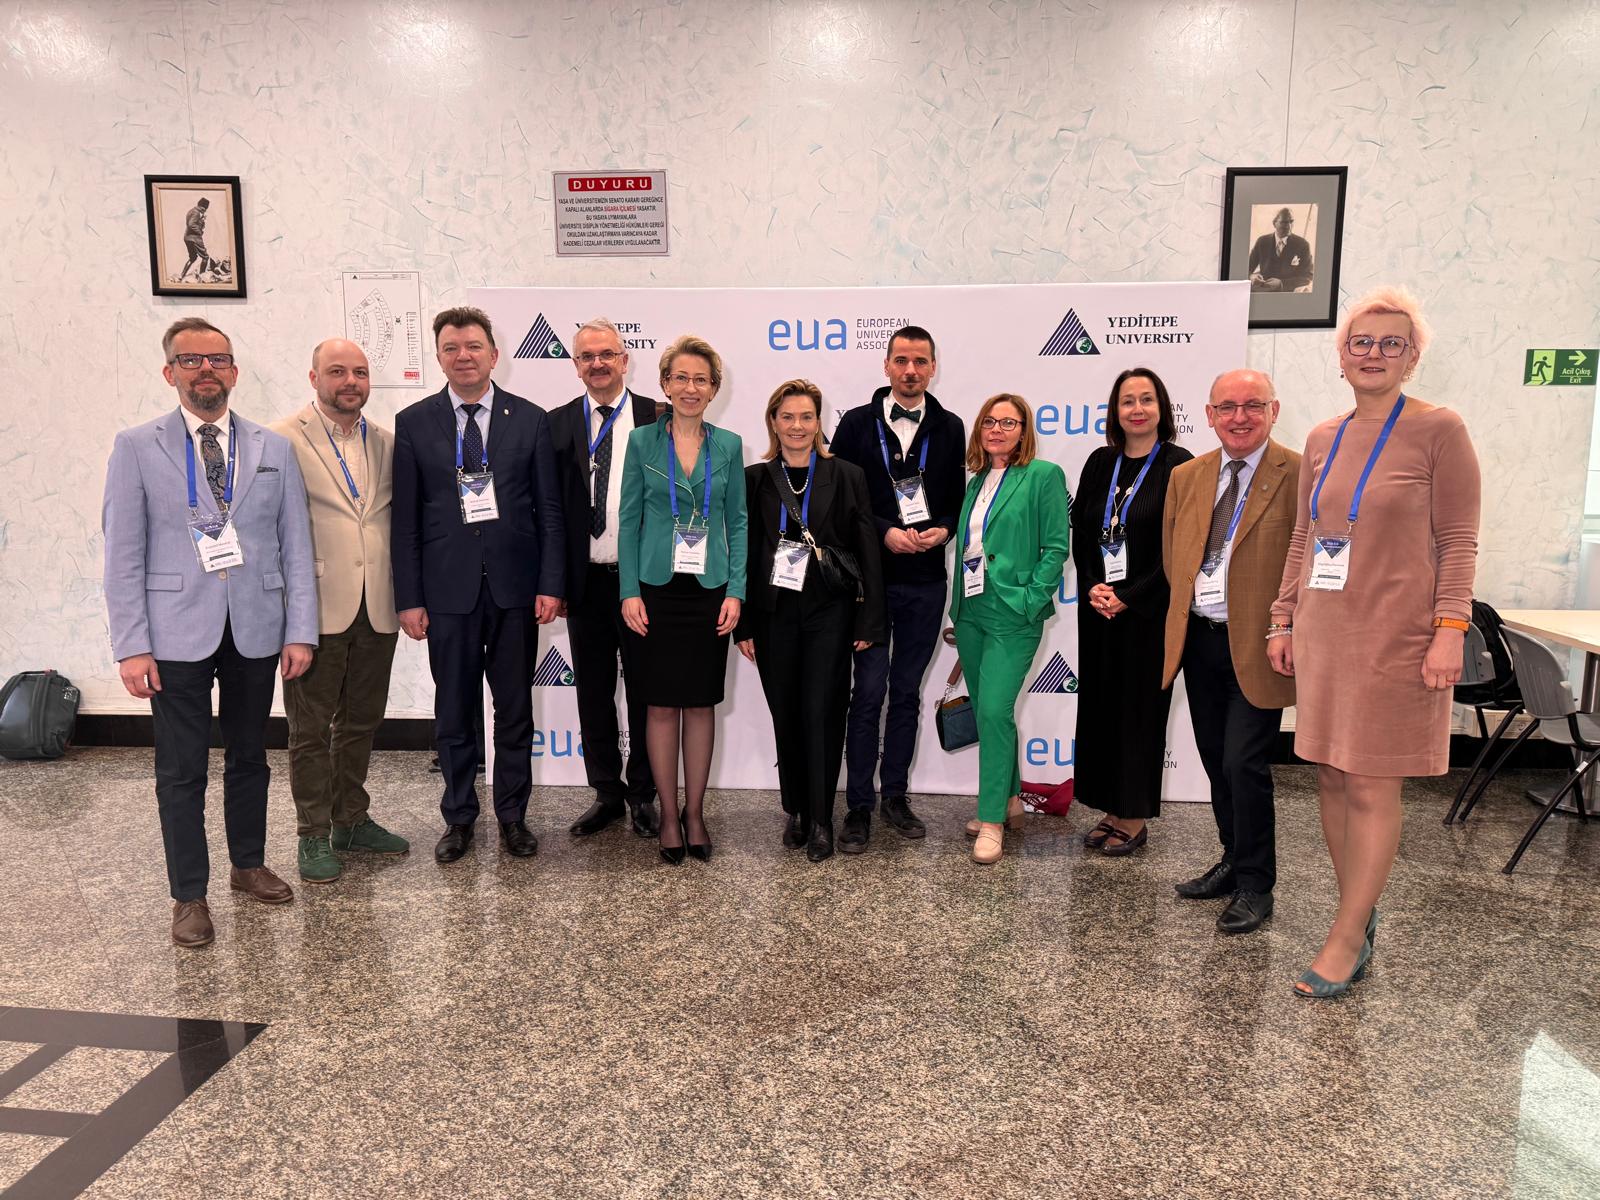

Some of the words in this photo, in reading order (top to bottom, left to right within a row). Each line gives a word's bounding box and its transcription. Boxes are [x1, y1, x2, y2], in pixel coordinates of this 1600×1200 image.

[573, 179, 648, 190] DUYURU
[856, 318, 910, 328] EUROPEAN
[1107, 314, 1178, 328] YEDİTEPE
[768, 318, 847, 351] eua
[856, 330, 897, 339] UNIVER
[1106, 333, 1194, 345] UNIVERSITY
[531, 730, 584, 758] eu
